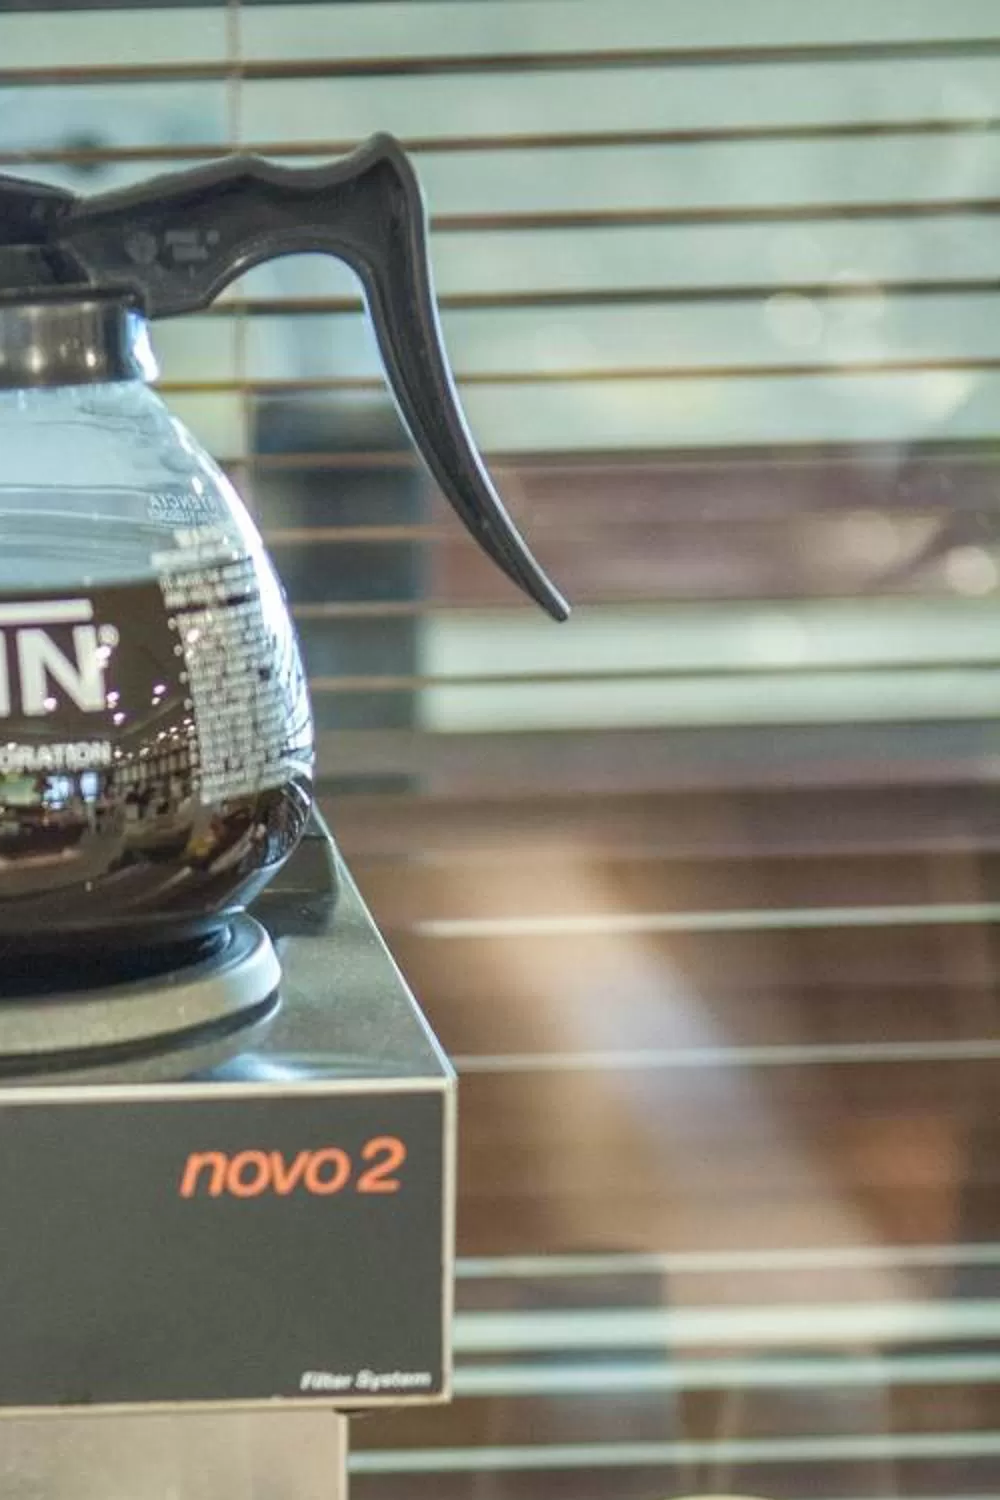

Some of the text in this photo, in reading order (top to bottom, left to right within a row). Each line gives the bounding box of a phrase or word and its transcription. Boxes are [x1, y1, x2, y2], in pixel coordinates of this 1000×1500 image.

[180, 1134, 407, 1199] novo 2
[300, 1369, 432, 1392] Filter System
